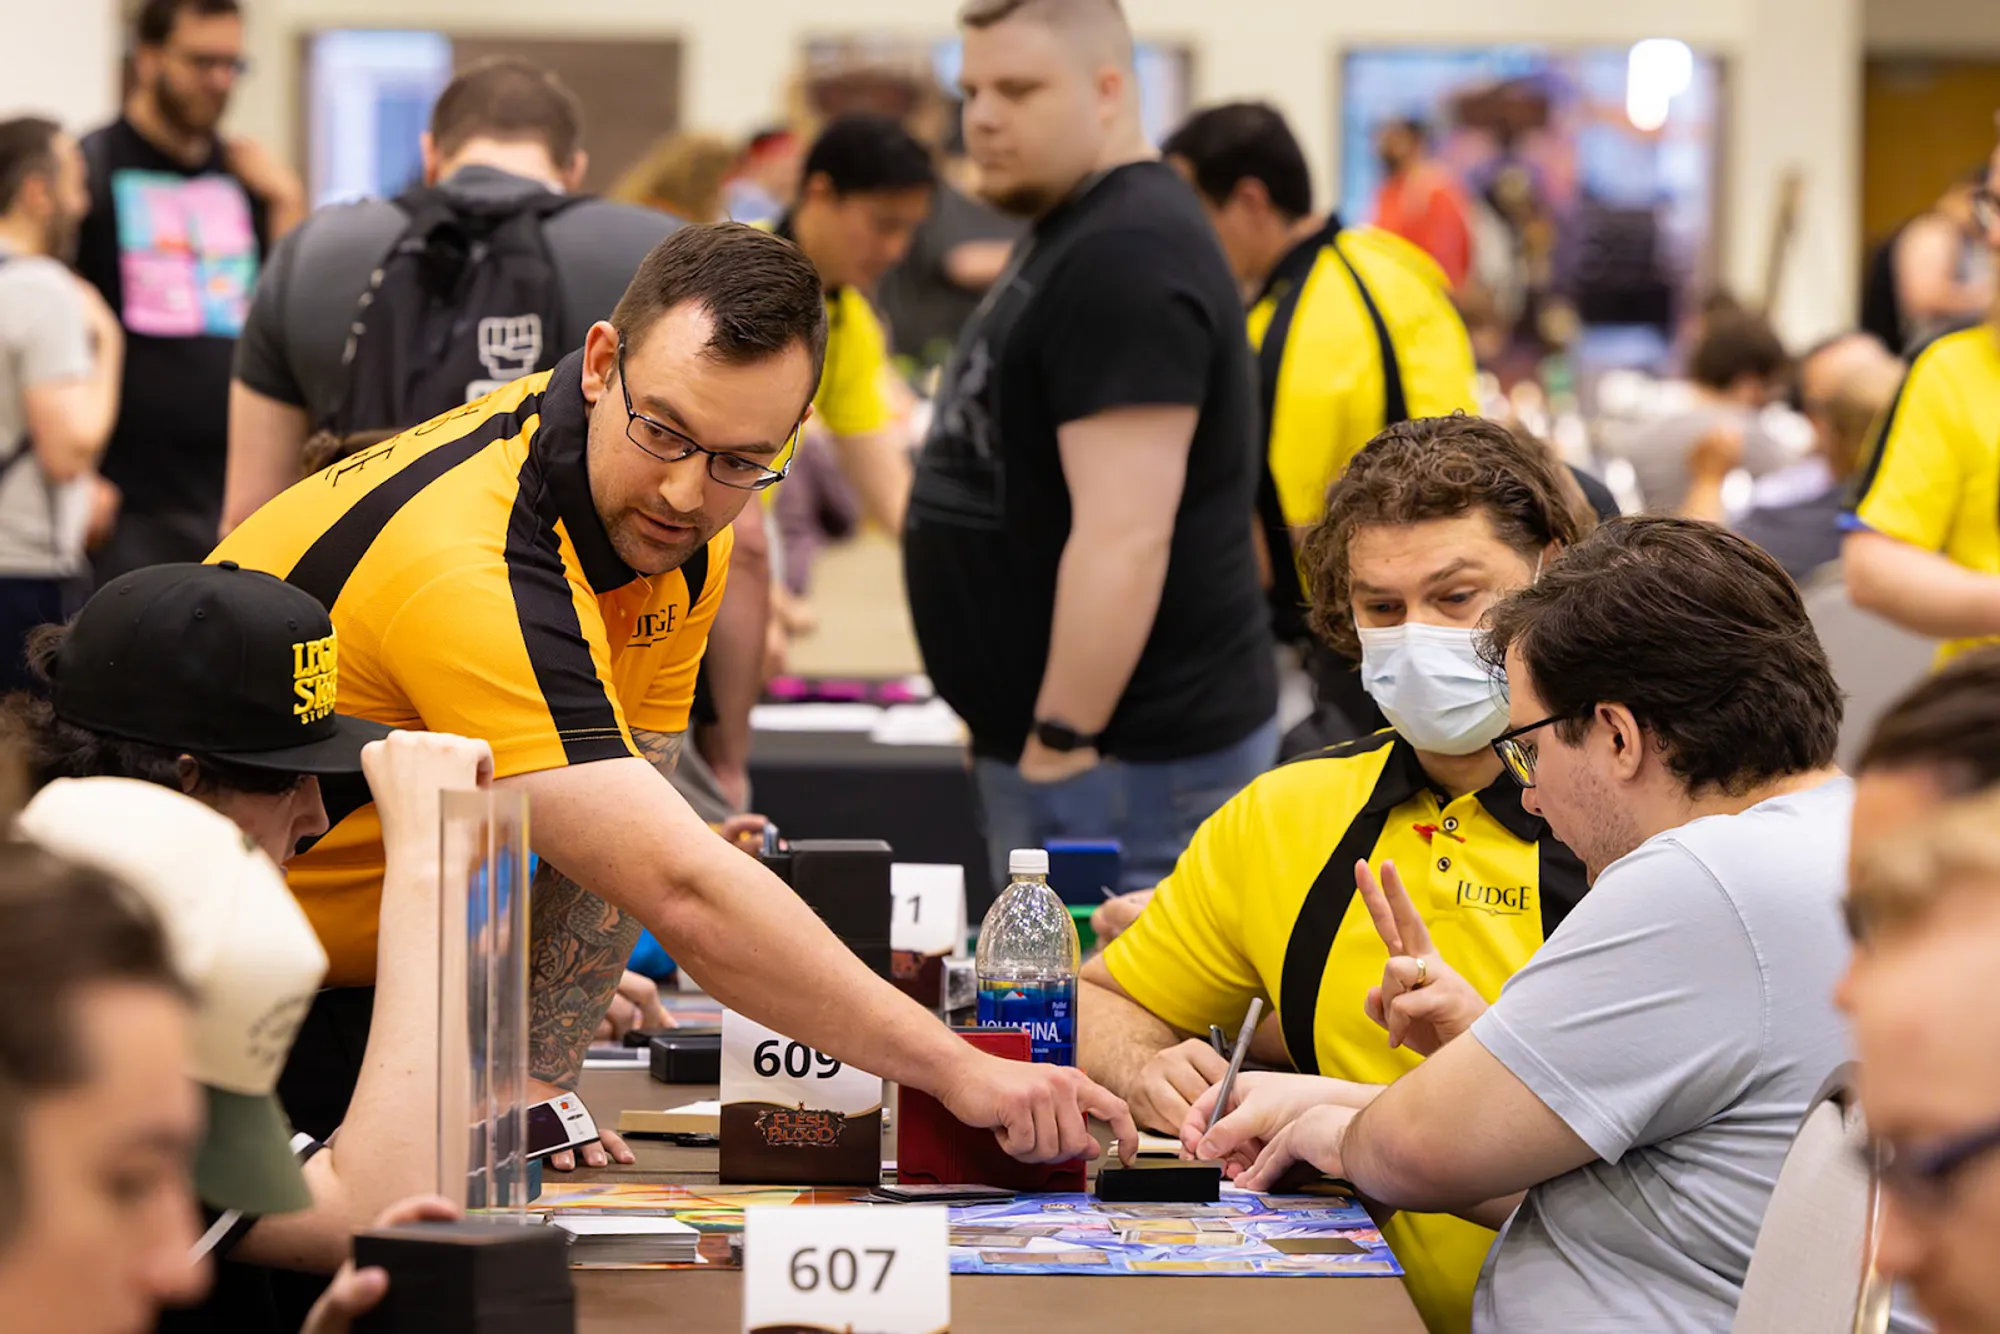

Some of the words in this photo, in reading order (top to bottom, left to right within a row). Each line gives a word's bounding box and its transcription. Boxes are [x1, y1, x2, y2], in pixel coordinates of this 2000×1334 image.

[1456, 880, 1532, 911] JUDGE
[753, 1040, 842, 1079] 609
[767, 1126, 836, 1142] BLOOD
[773, 1112, 829, 1129] FLESH
[788, 1246, 898, 1293] 607
